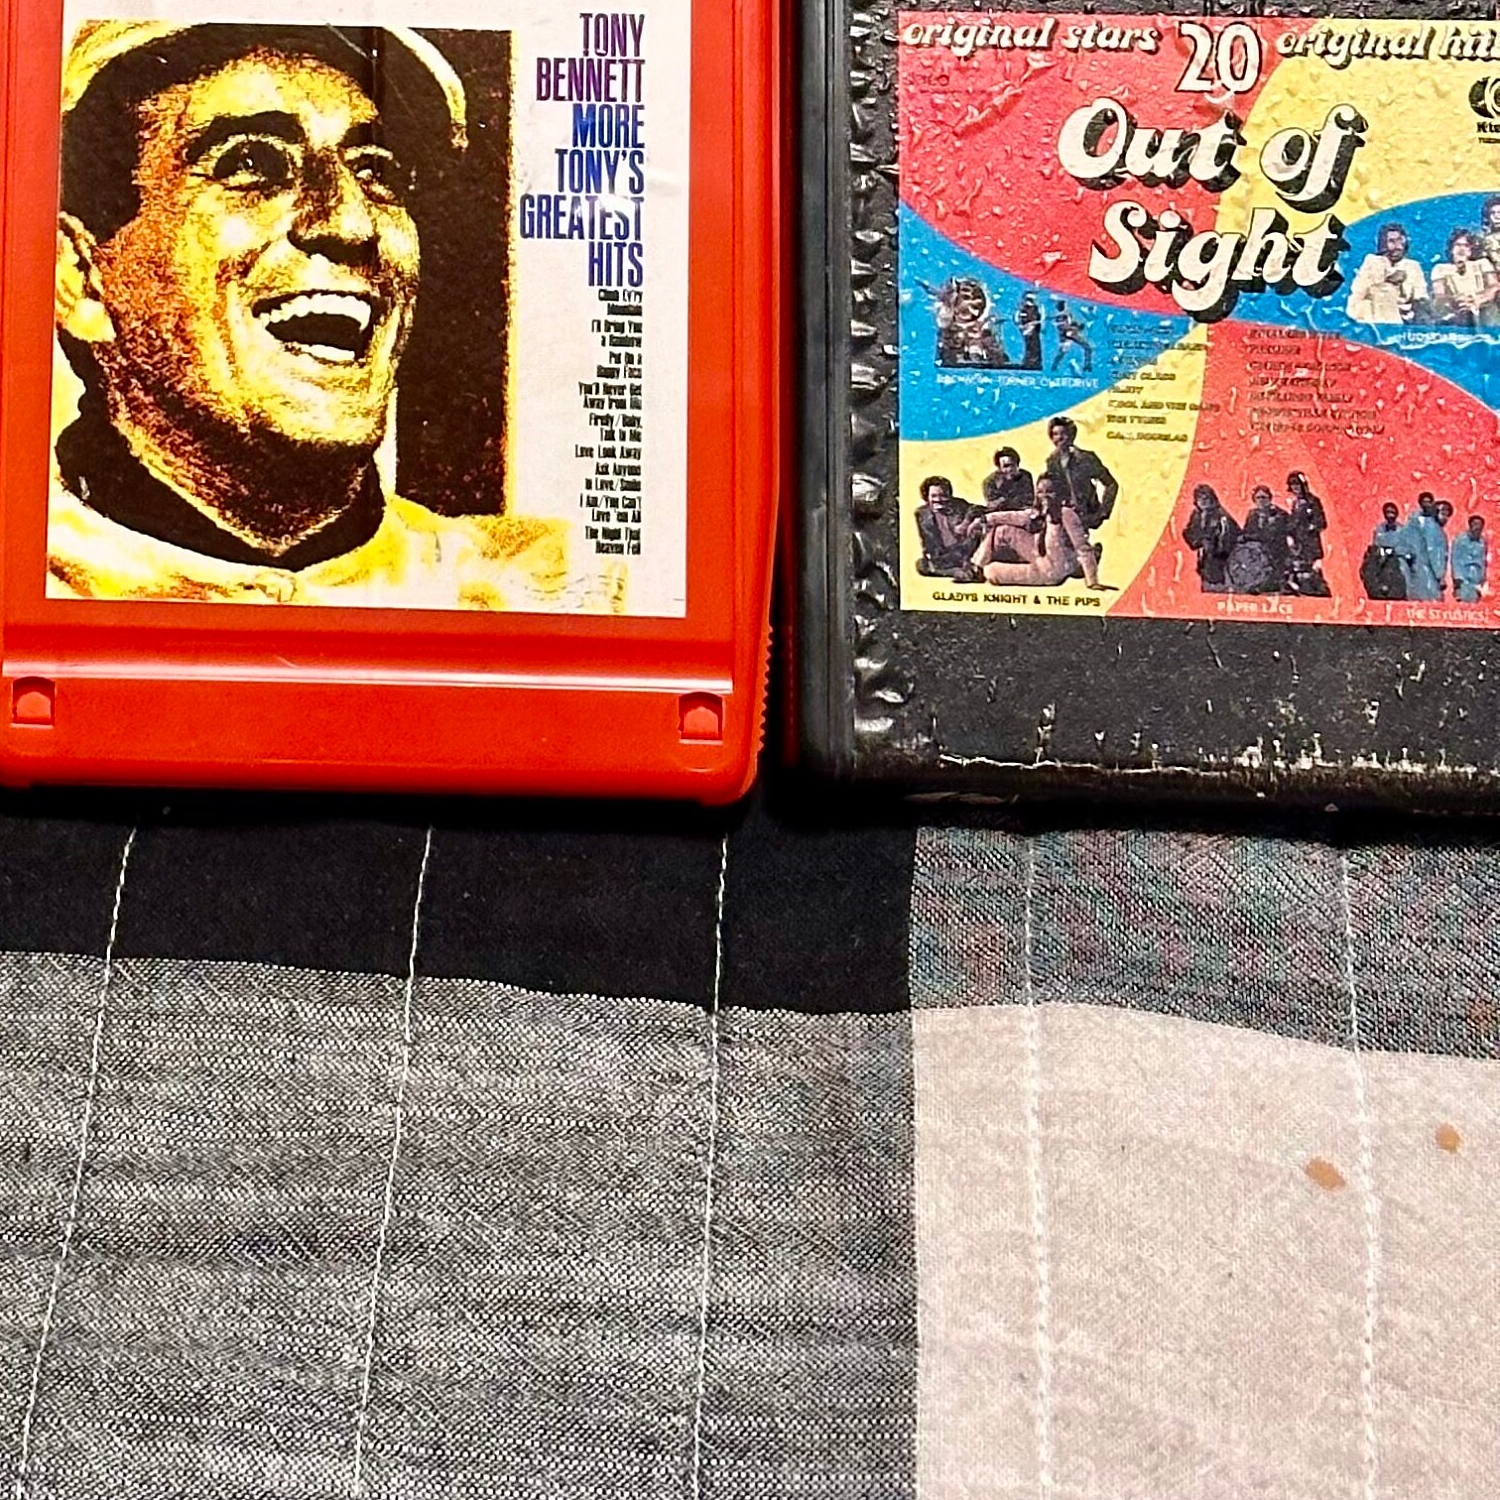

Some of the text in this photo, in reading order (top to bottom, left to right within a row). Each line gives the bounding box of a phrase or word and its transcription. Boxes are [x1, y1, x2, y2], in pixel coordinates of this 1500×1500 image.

[579, 12, 645, 57] TONY
[903, 17, 1057, 60] original
[1063, 25, 1162, 53] stars
[1176, 21, 1262, 93] 20
[1276, 24, 1436, 69] original
[536, 57, 646, 103] BENNETT
[572, 103, 645, 149] MORE
[555, 148, 645, 195] TONY'S
[1057, 97, 1367, 210] Out of
[520, 193, 645, 241] GREATEST
[588, 241, 644, 287] HITS
[1089, 200, 1349, 324] Sight
[1046, 595, 1070, 606] THE
